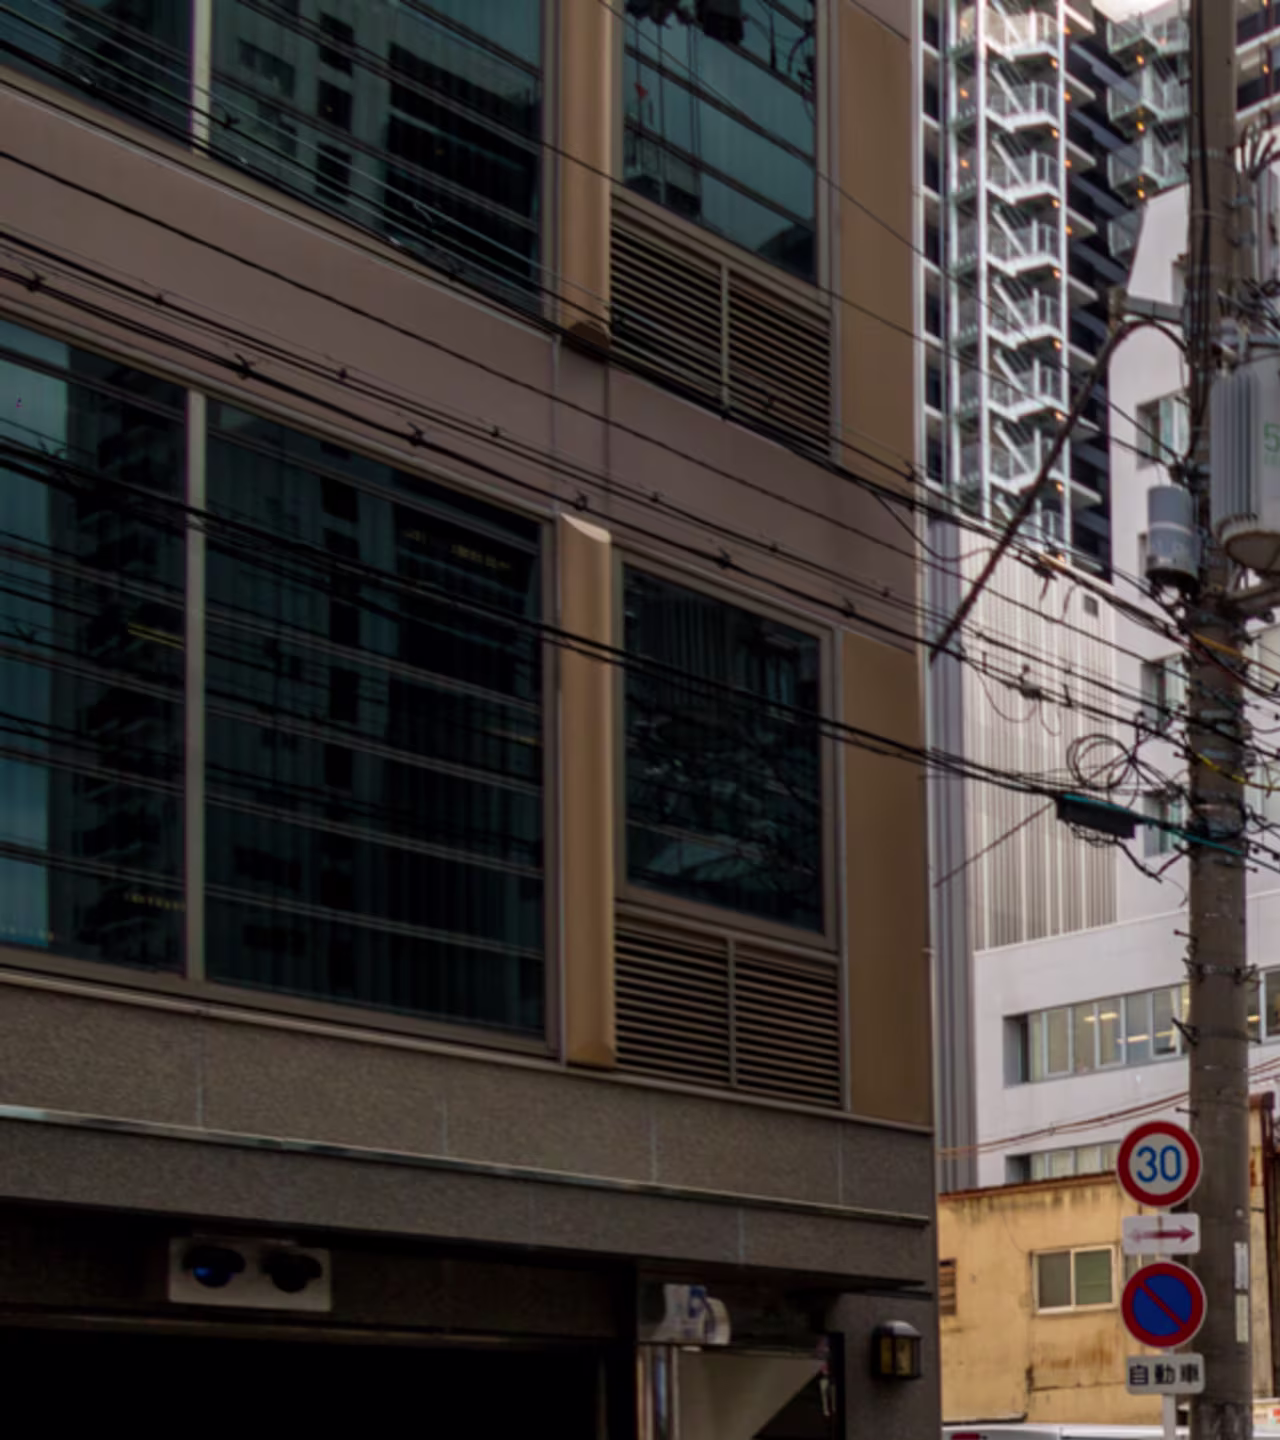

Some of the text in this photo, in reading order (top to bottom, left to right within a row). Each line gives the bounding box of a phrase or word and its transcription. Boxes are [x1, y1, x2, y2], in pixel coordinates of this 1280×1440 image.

[1136, 1145, 1181, 1183] 30
[1129, 1363, 1201, 1387] 自動車
